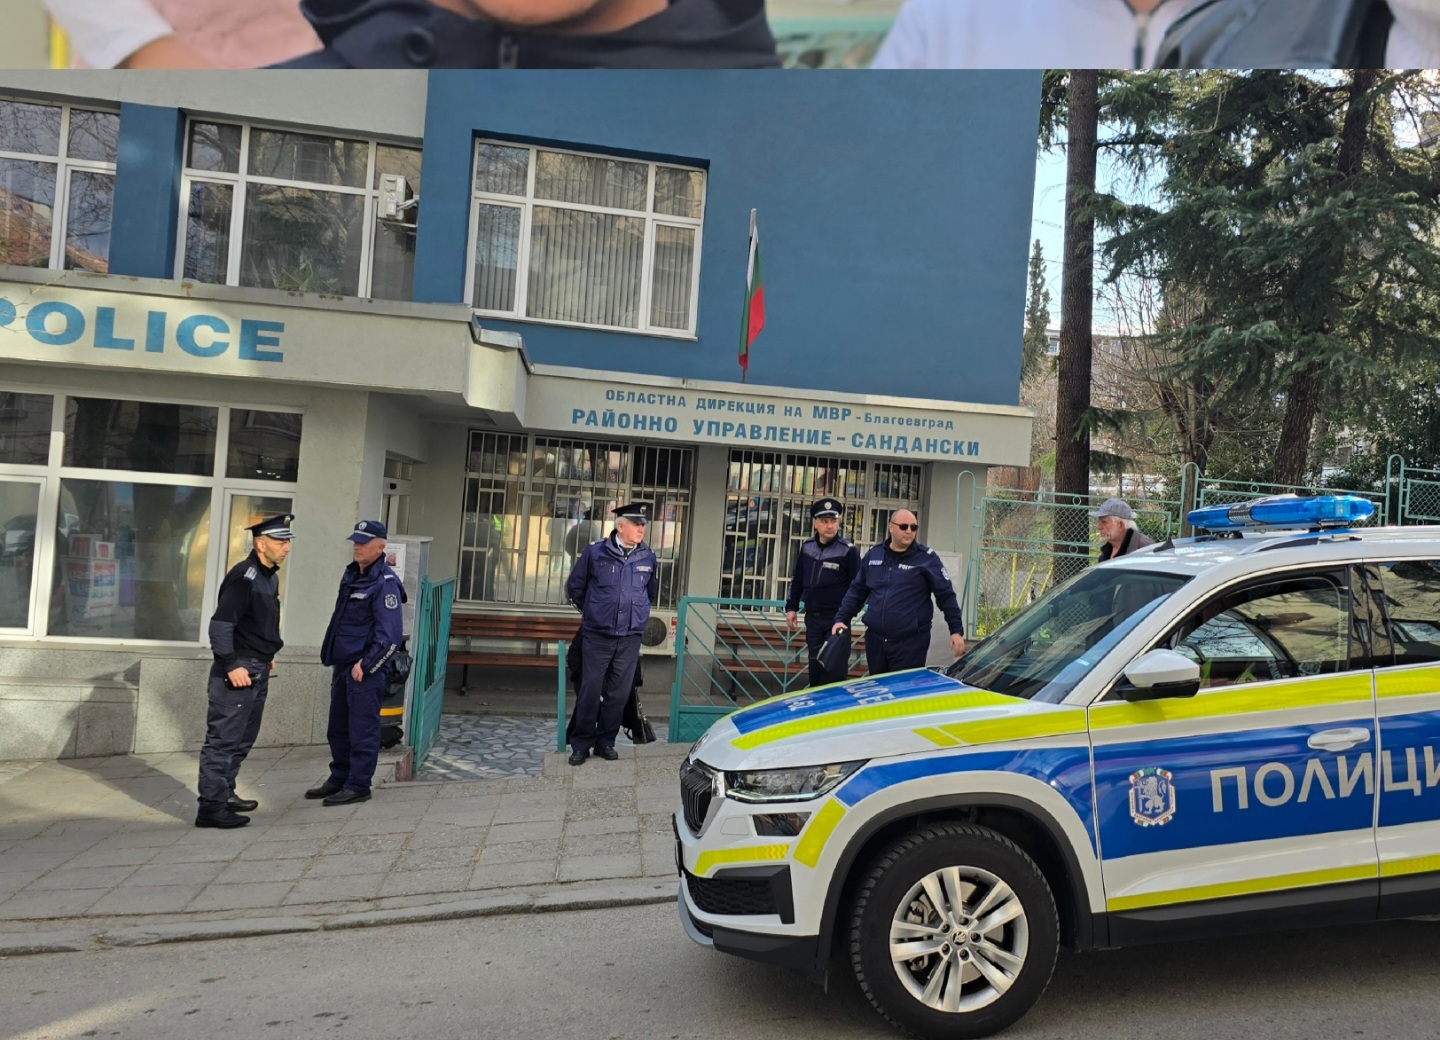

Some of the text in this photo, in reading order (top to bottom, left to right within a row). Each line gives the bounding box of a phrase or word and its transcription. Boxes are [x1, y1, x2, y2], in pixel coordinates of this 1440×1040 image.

[605, 389, 687, 408] ОБЛАСТНА
[696, 397, 776, 416] ДИРЕКЦИЯ
[784, 405, 803, 418] НА
[571, 408, 678, 433] РАЙОННО
